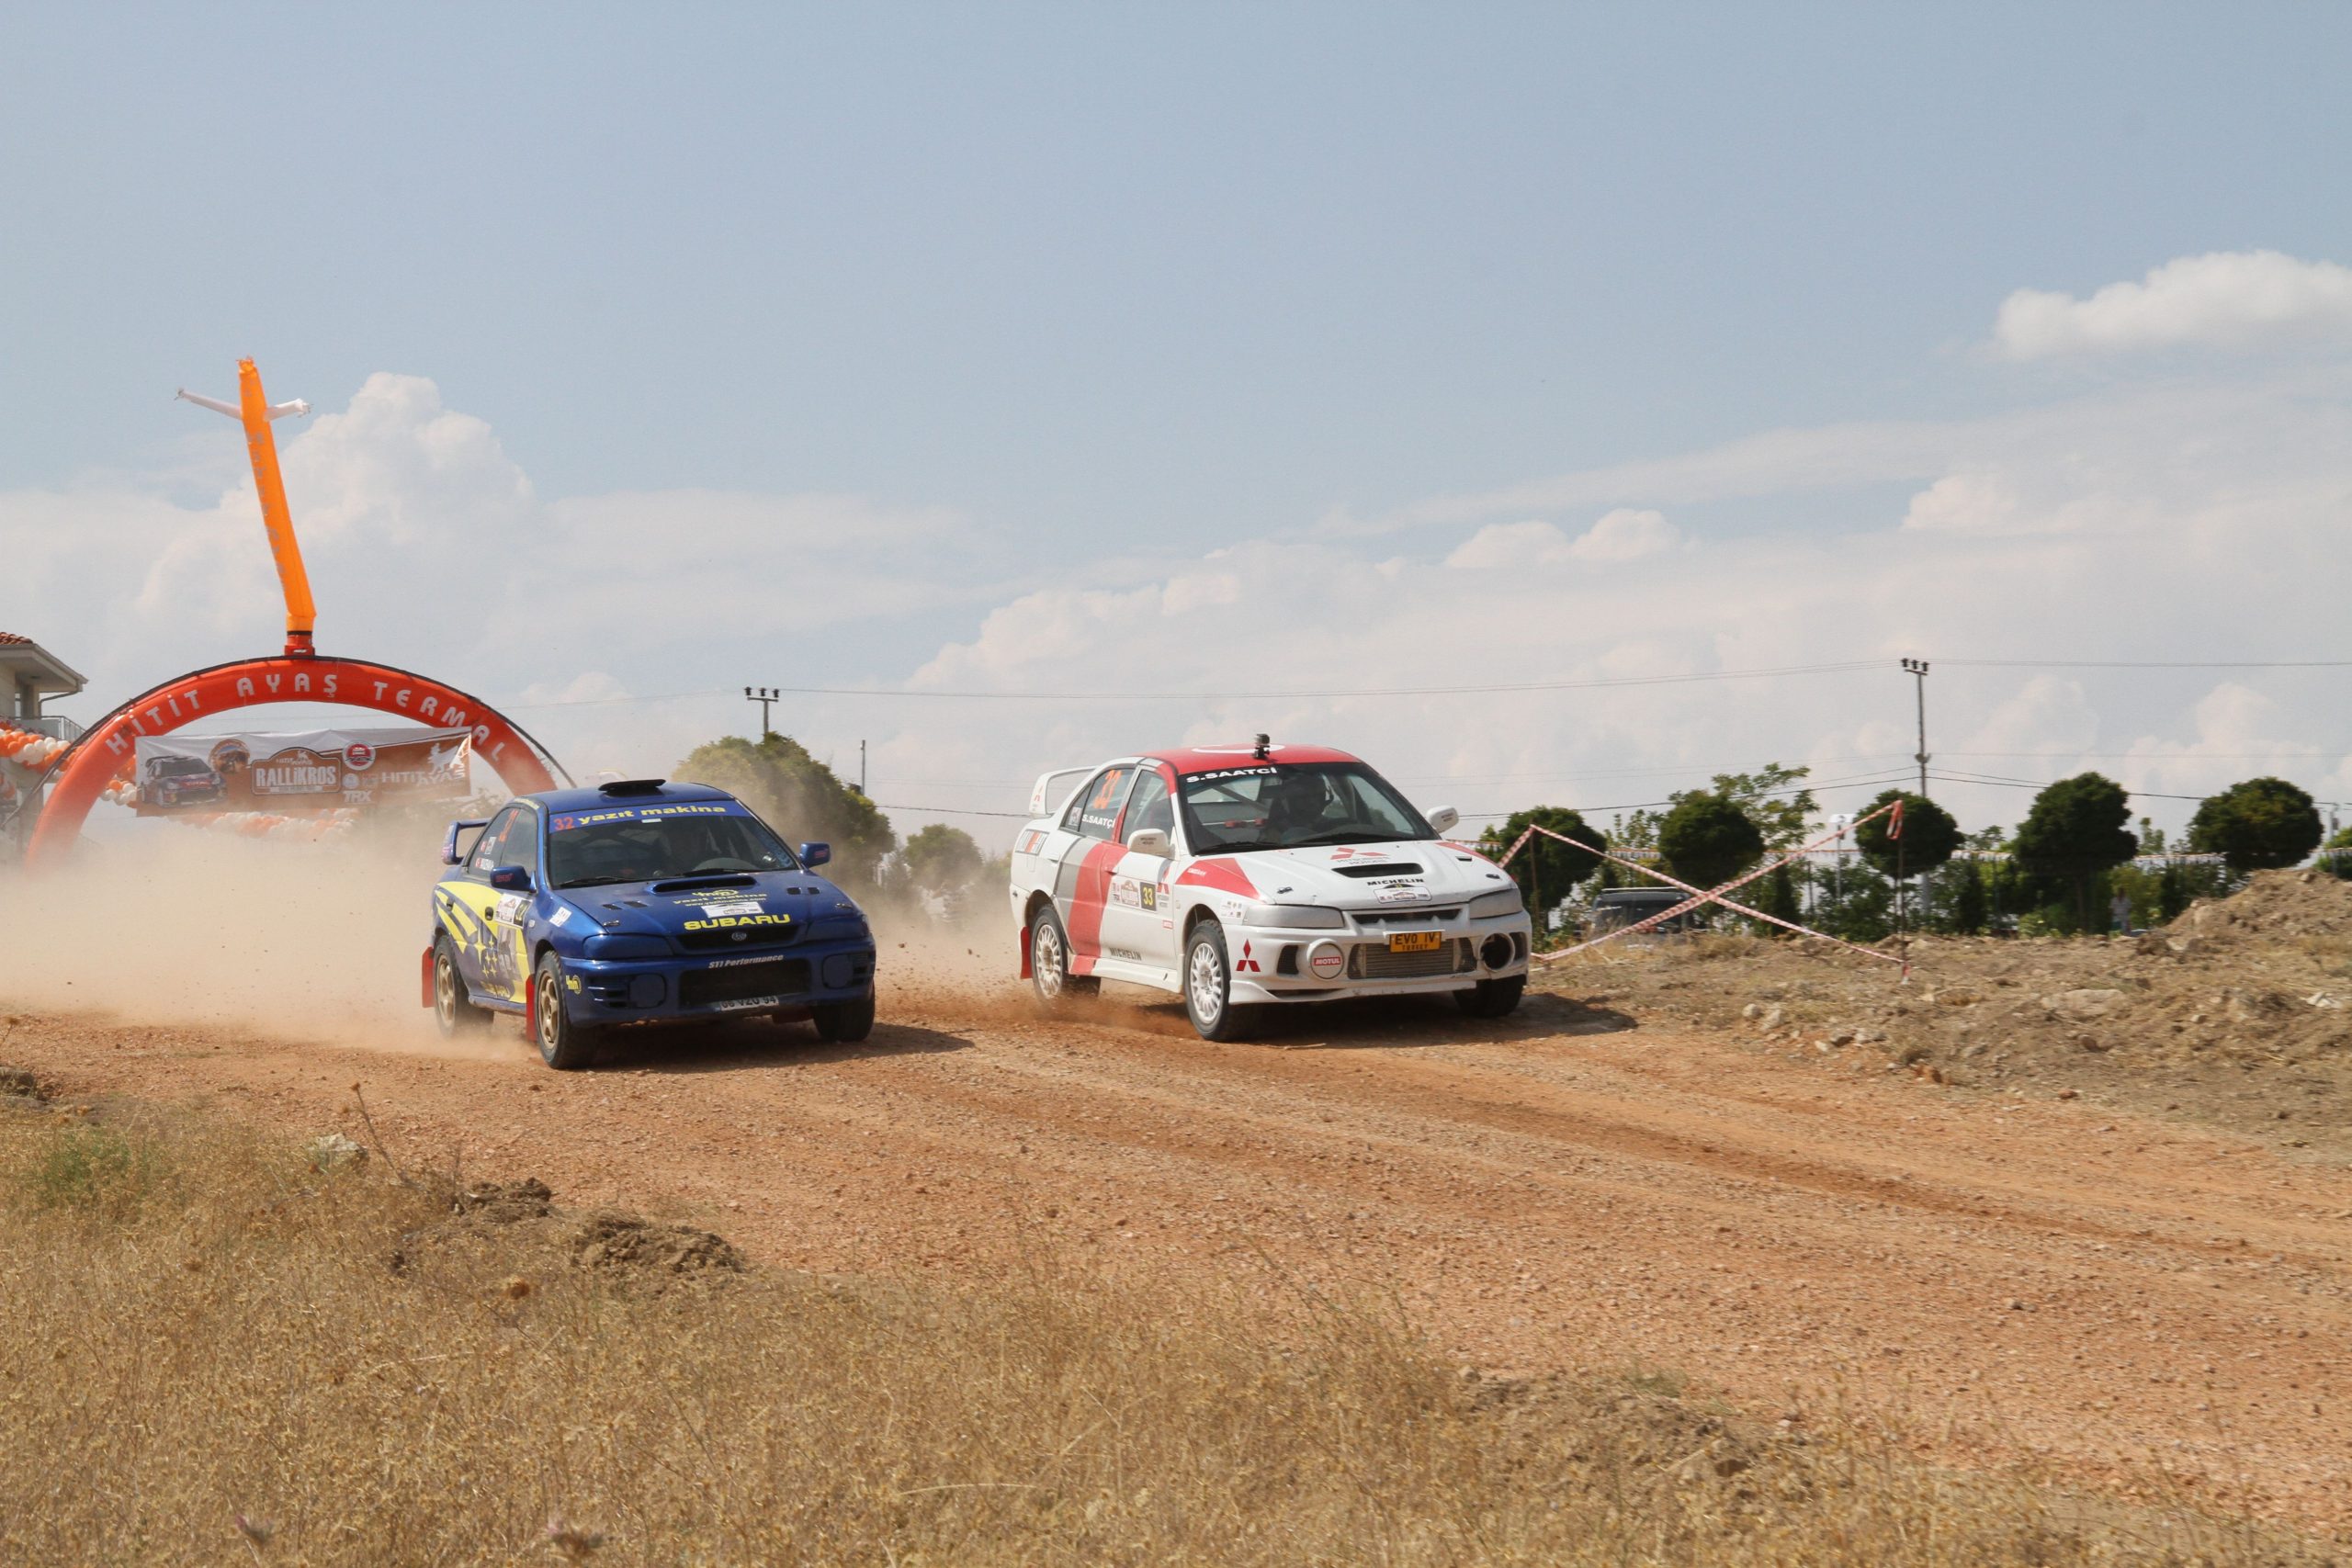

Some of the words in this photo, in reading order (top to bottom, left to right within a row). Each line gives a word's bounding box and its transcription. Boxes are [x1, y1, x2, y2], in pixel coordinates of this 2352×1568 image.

[236, 672, 337, 698] AYAŞ
[374, 681, 505, 762] TERMAL
[553, 817, 575, 831] 32
[640, 806, 727, 817] makina
[1367, 878, 1424, 886] MICHELIN
[1142, 886, 1154, 906] 33
[684, 914, 790, 931] SUBARU
[1395, 933, 1418, 945] EVO
[1424, 931, 1435, 942] IV
[724, 954, 784, 967] Performance
[1109, 947, 1142, 961] MICHELIN
[1315, 957, 1340, 965] MOTUL
